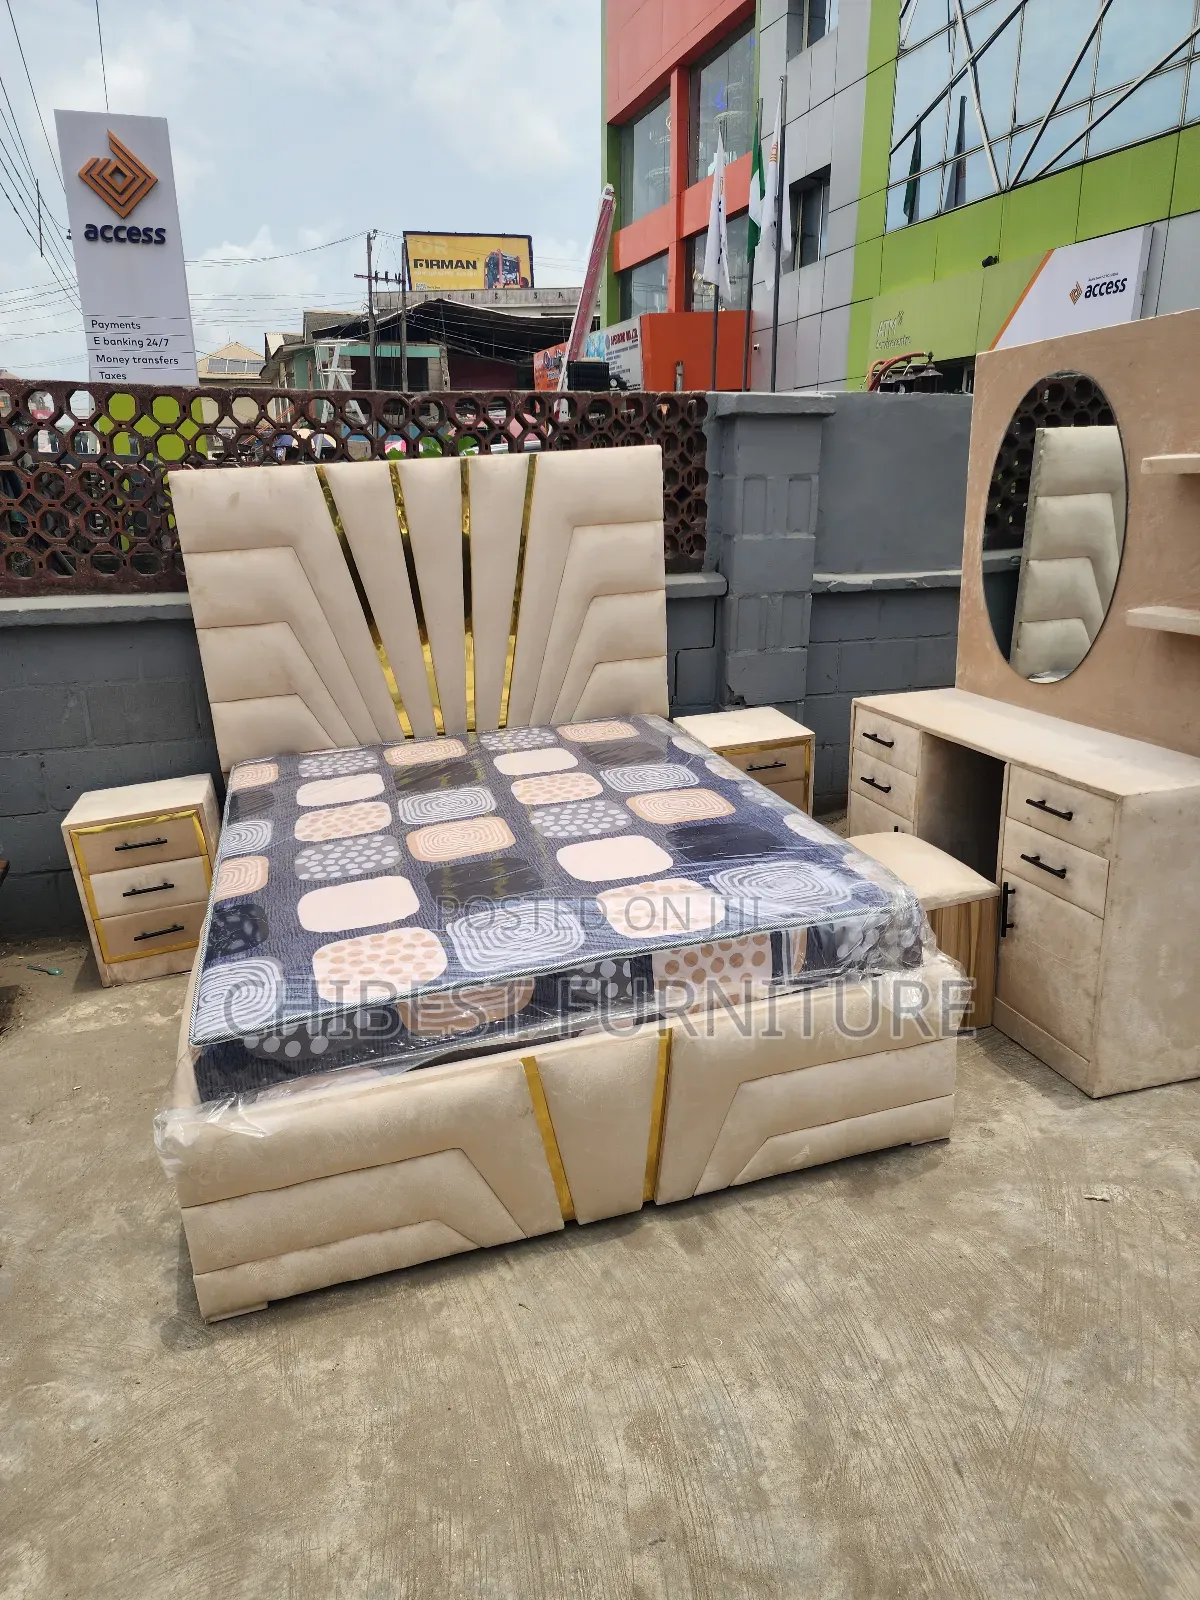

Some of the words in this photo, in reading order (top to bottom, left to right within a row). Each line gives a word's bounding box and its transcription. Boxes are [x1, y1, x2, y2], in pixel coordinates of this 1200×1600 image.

[84, 223, 166, 245] access
[413, 258, 477, 270] FIRMAN
[1084, 277, 1128, 299] access
[91, 319, 141, 330] Payments
[93, 336, 101, 345] E
[103, 337, 144, 348] banking
[145, 337, 169, 347] 24/7
[96, 354, 130, 365] Money
[132, 355, 179, 365] transfers
[99, 371, 127, 381] Taxes
